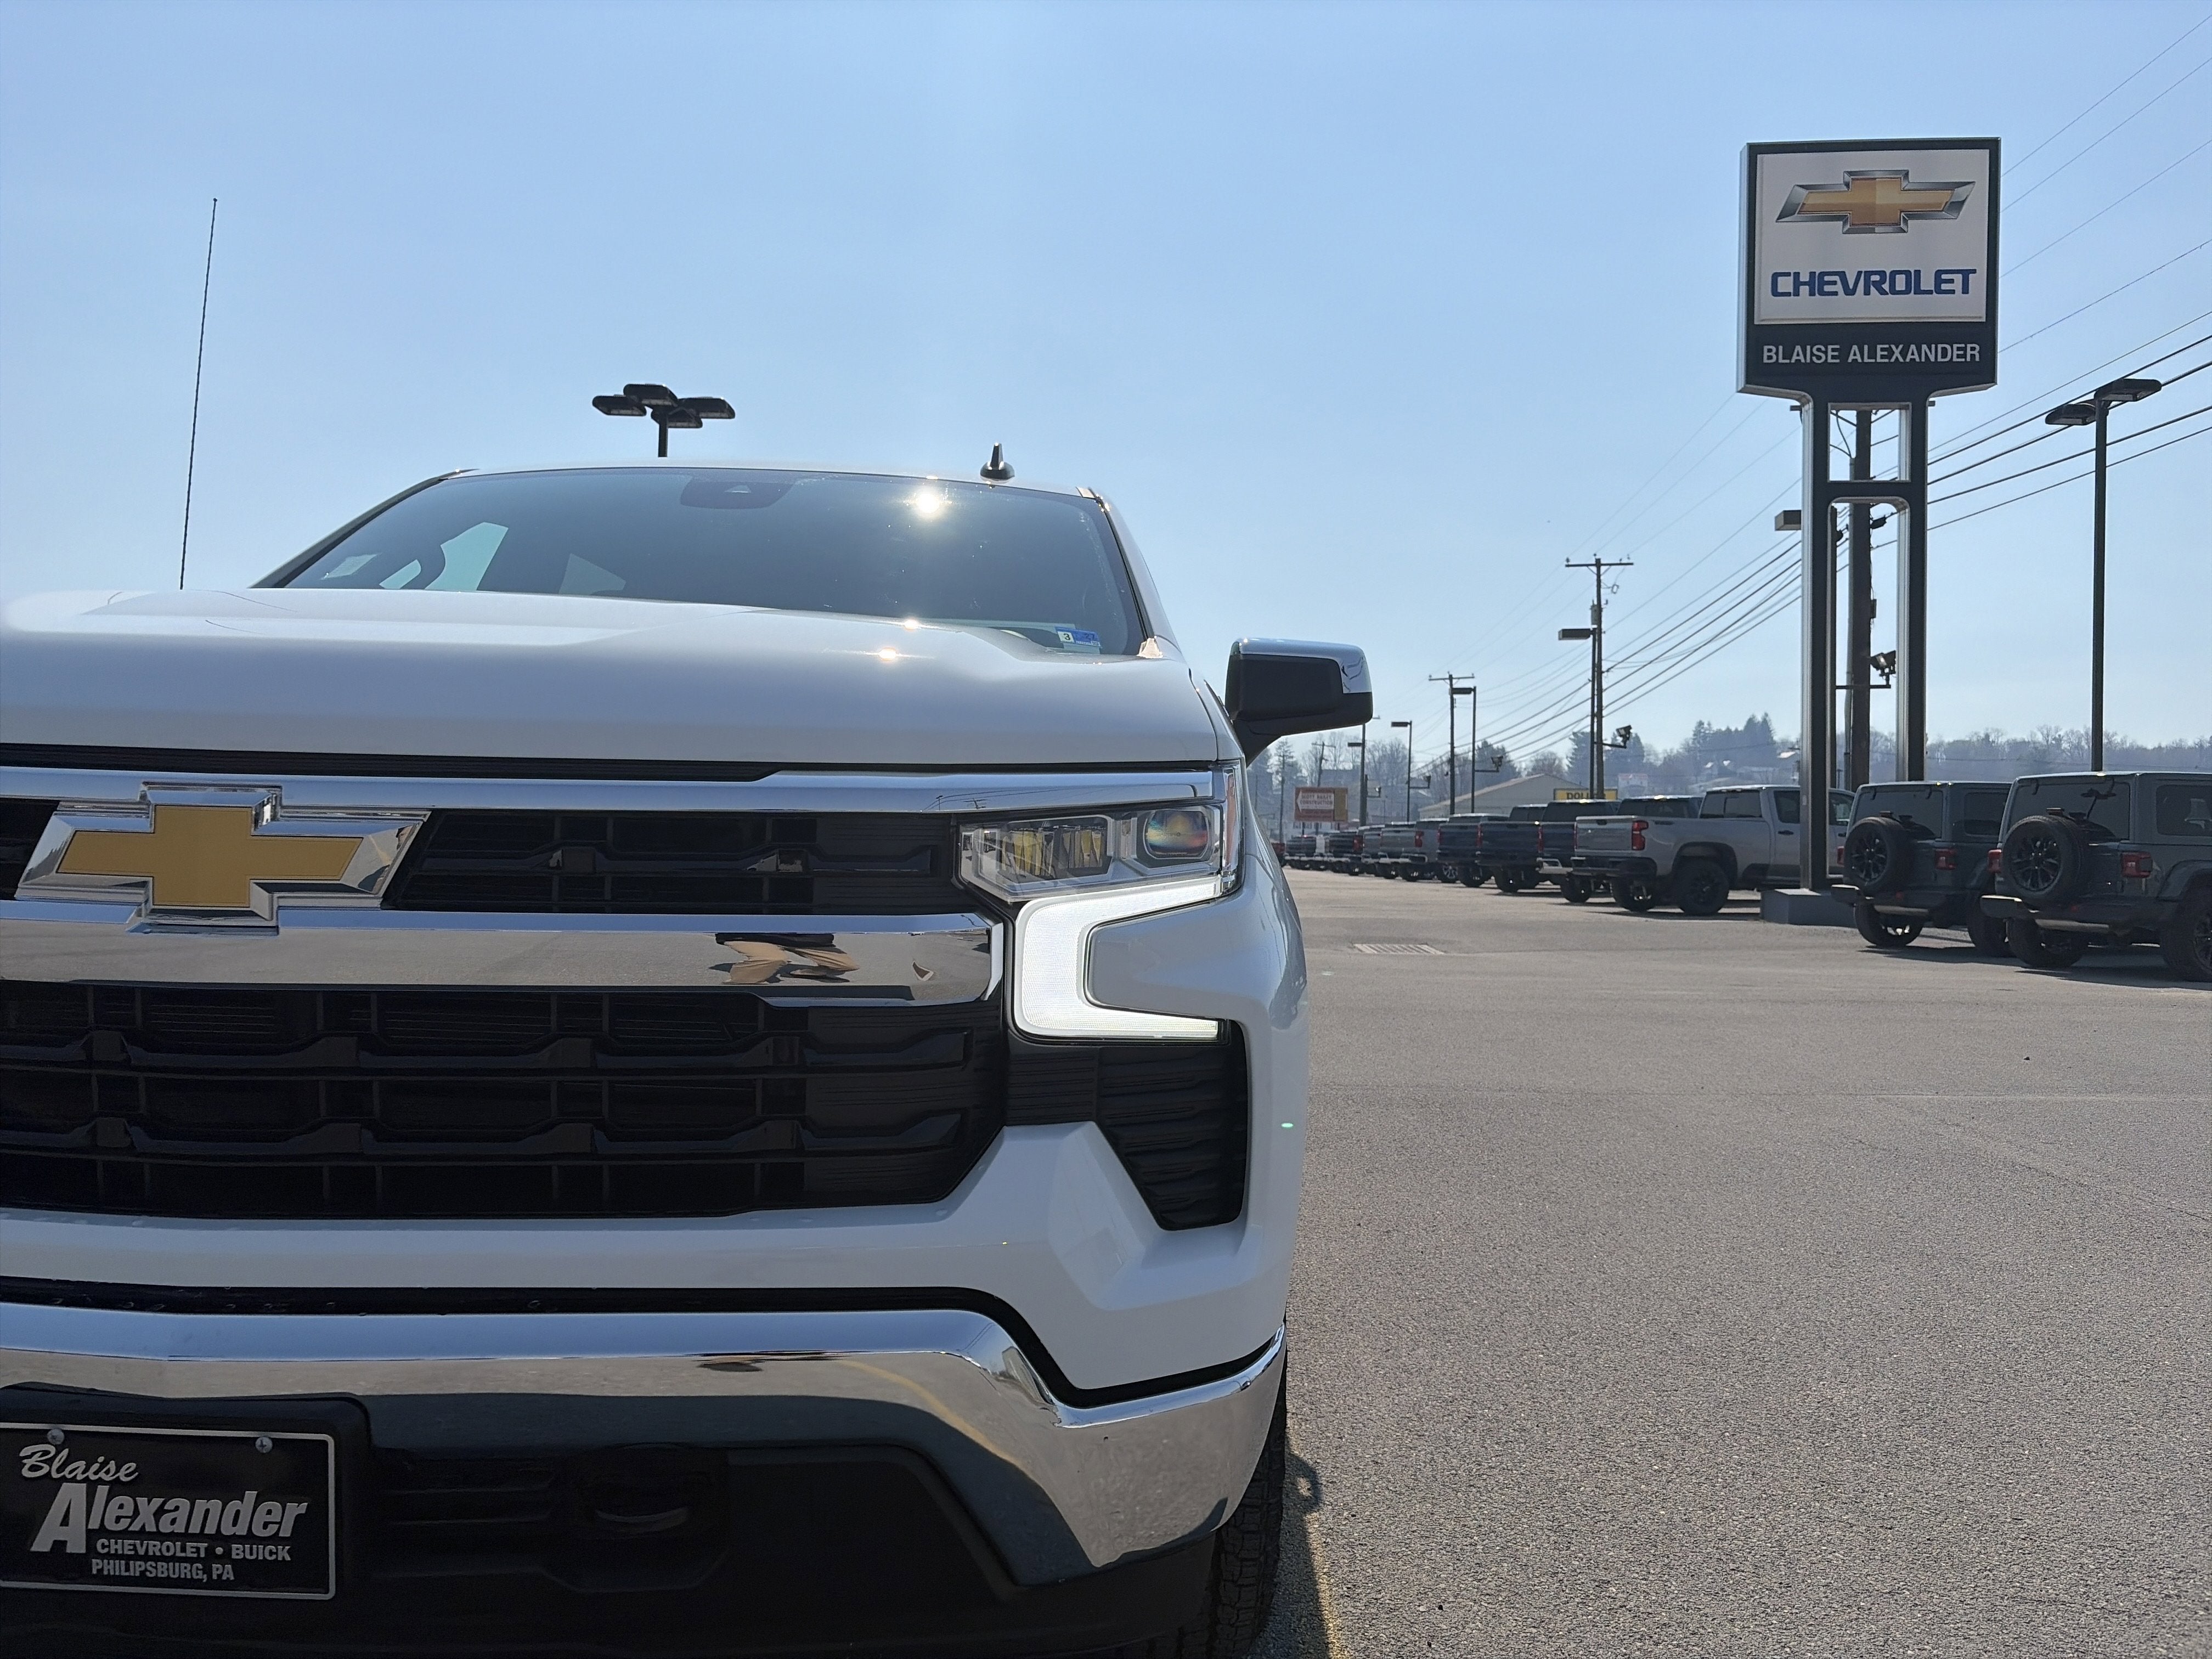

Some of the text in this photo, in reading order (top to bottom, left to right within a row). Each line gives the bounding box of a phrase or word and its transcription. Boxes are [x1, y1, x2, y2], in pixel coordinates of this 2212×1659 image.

[1770, 269, 1977, 297] CHEVROLET
[1762, 343, 1980, 364] BLAISE ALEXANDER
[19, 1443, 139, 1481] Blaise
[30, 1482, 308, 1554] Alexander
[96, 1538, 291, 1561] CHEVROLET BUICK
[91, 1559, 235, 1583] PHILIPSBURG, PA
